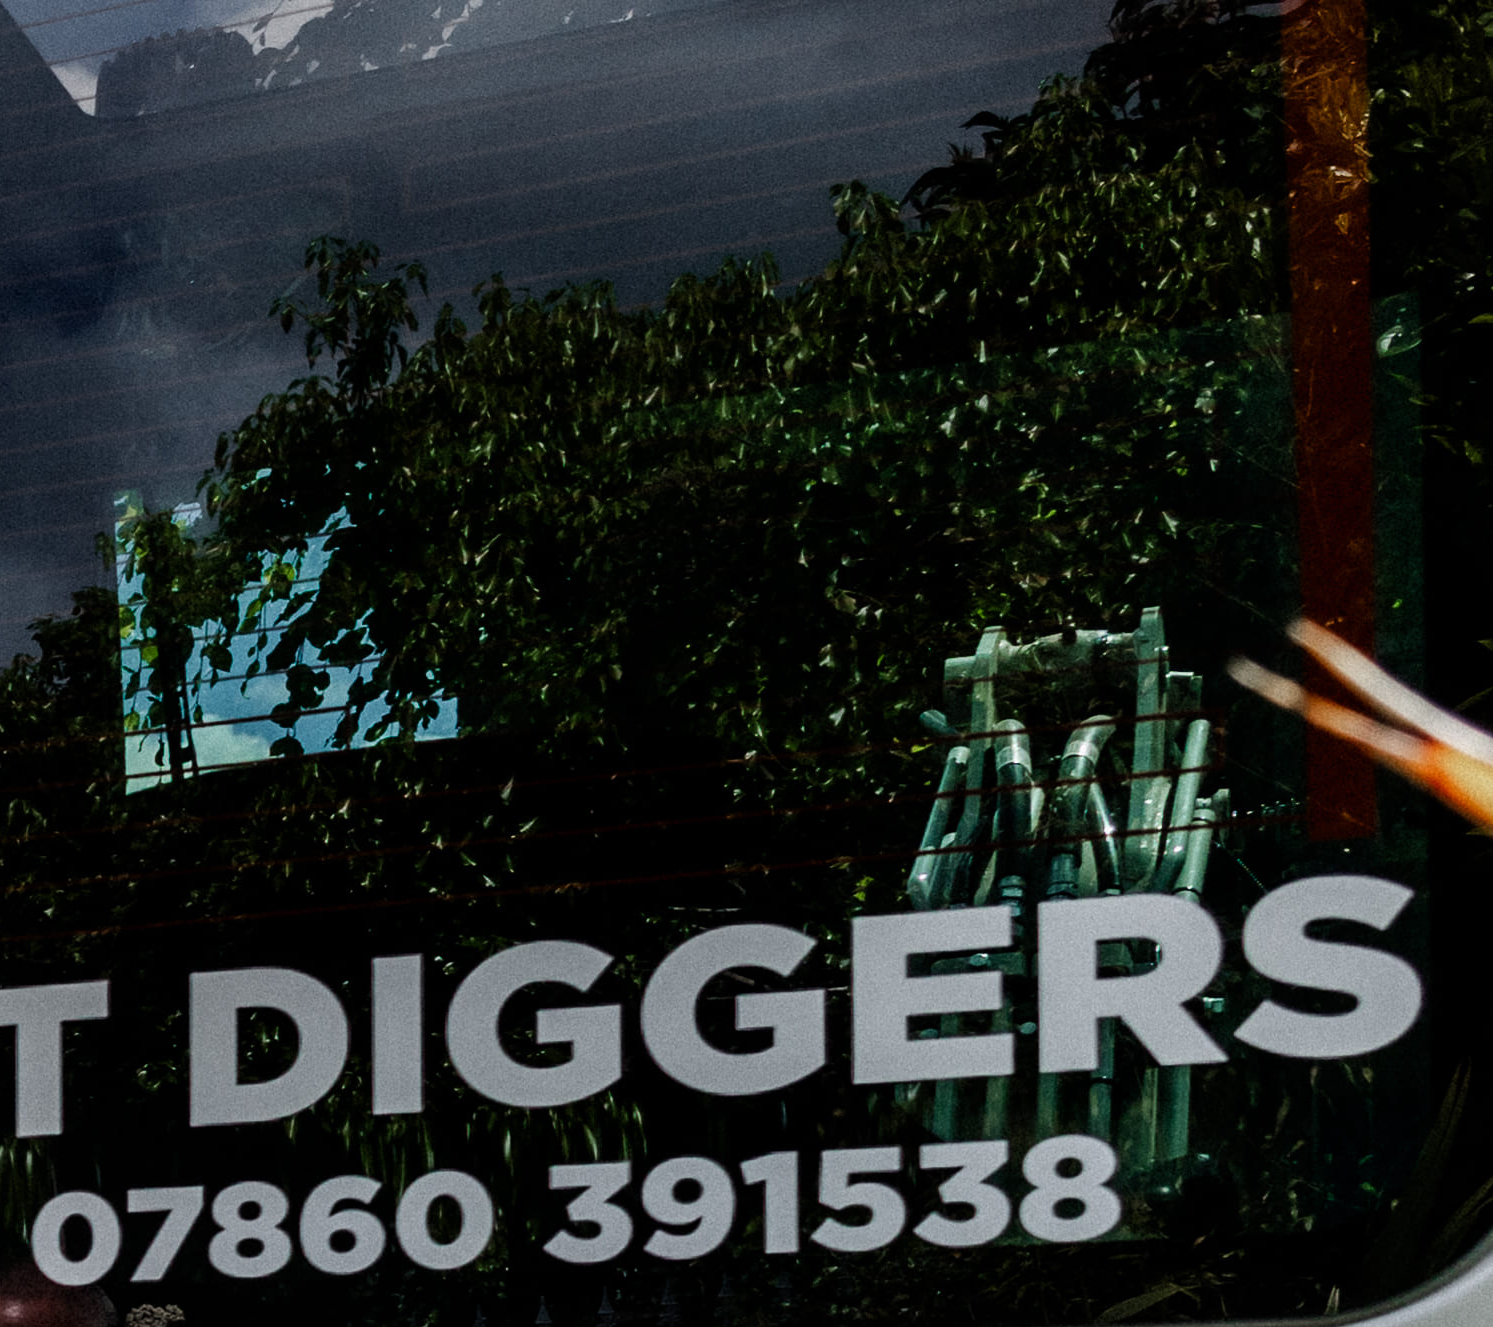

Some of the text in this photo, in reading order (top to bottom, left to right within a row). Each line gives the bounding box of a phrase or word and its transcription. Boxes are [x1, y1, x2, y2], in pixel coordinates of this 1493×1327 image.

[188, 875, 1422, 1127] DIGGERS
[31, 1169, 493, 1286] 07860
[545, 1134, 1122, 1264] 391538
